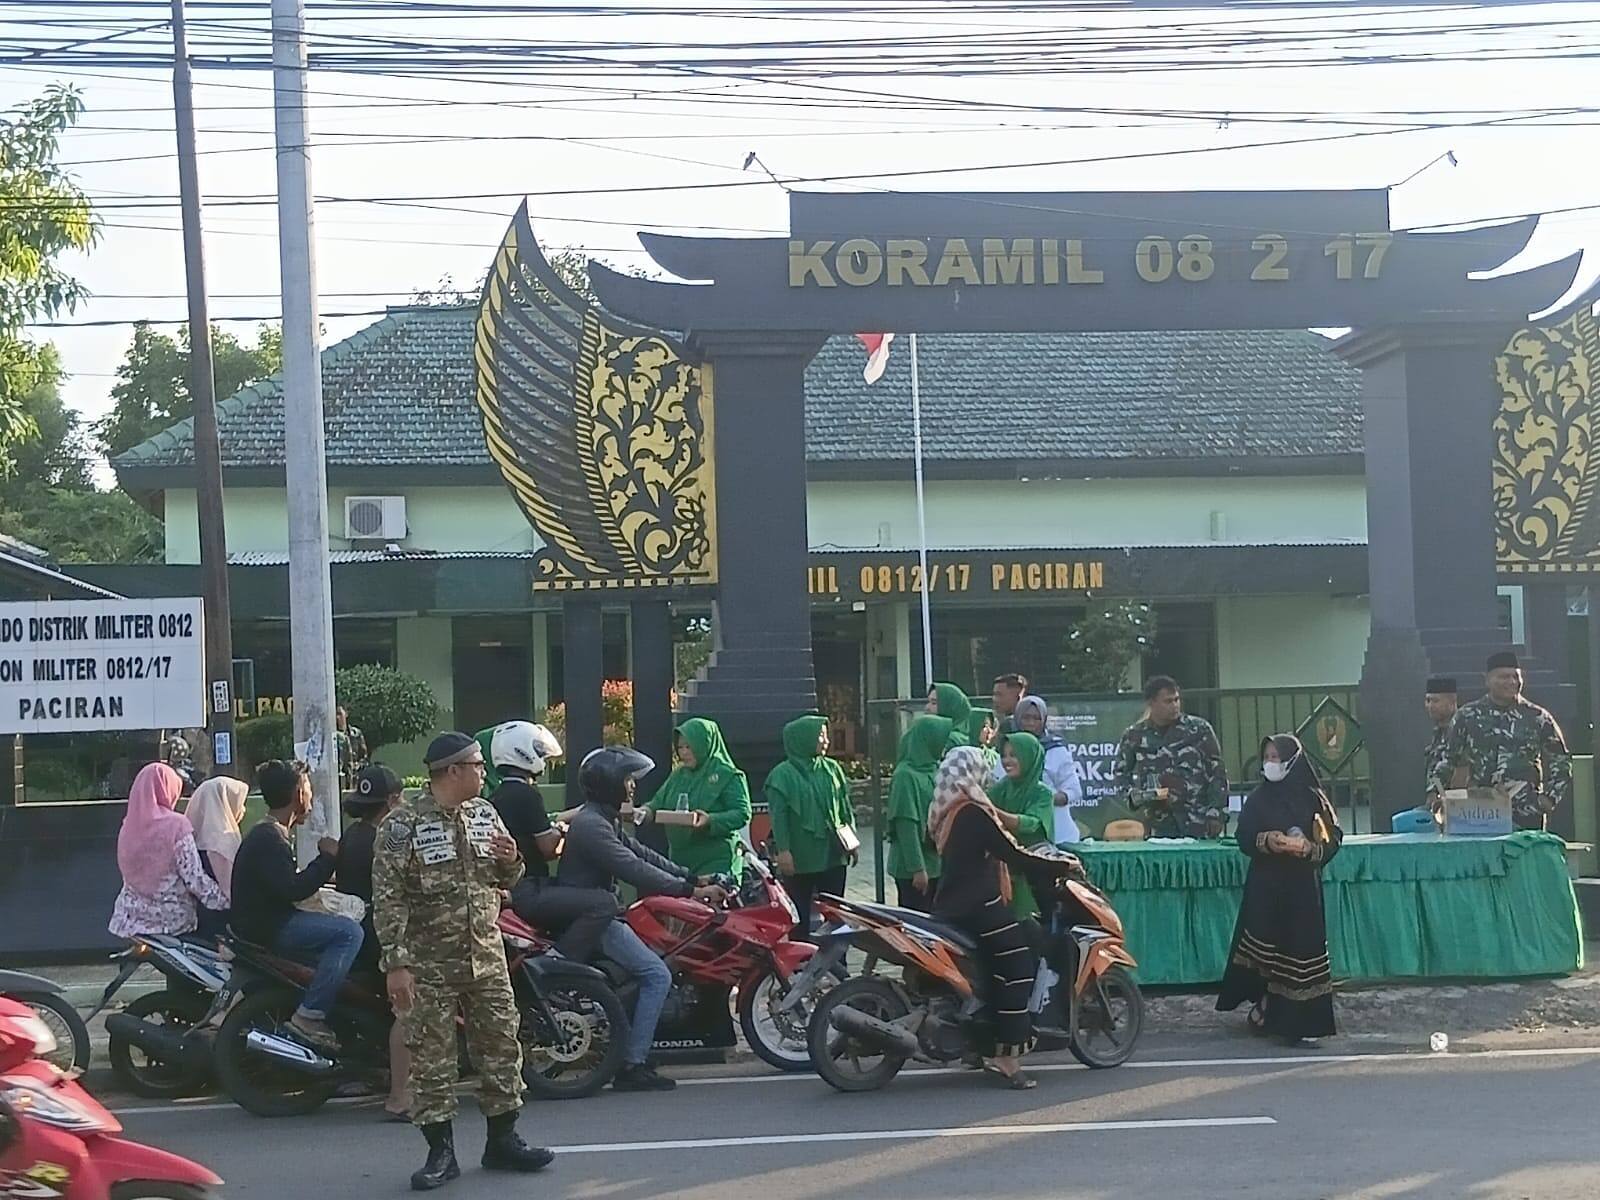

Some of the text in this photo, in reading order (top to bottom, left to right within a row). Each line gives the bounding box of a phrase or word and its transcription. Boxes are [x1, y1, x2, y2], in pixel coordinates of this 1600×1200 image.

[788, 238, 1104, 287] KORAMIL
[1324, 232, 1394, 279] 17
[992, 561, 1103, 591] PACIRAN
[0, 612, 193, 643] DO DISTRIK MILITER 0812
[33, 657, 97, 681] MILITER
[106, 656, 172, 680] 0812/17
[19, 696, 124, 720] PACIRAN
